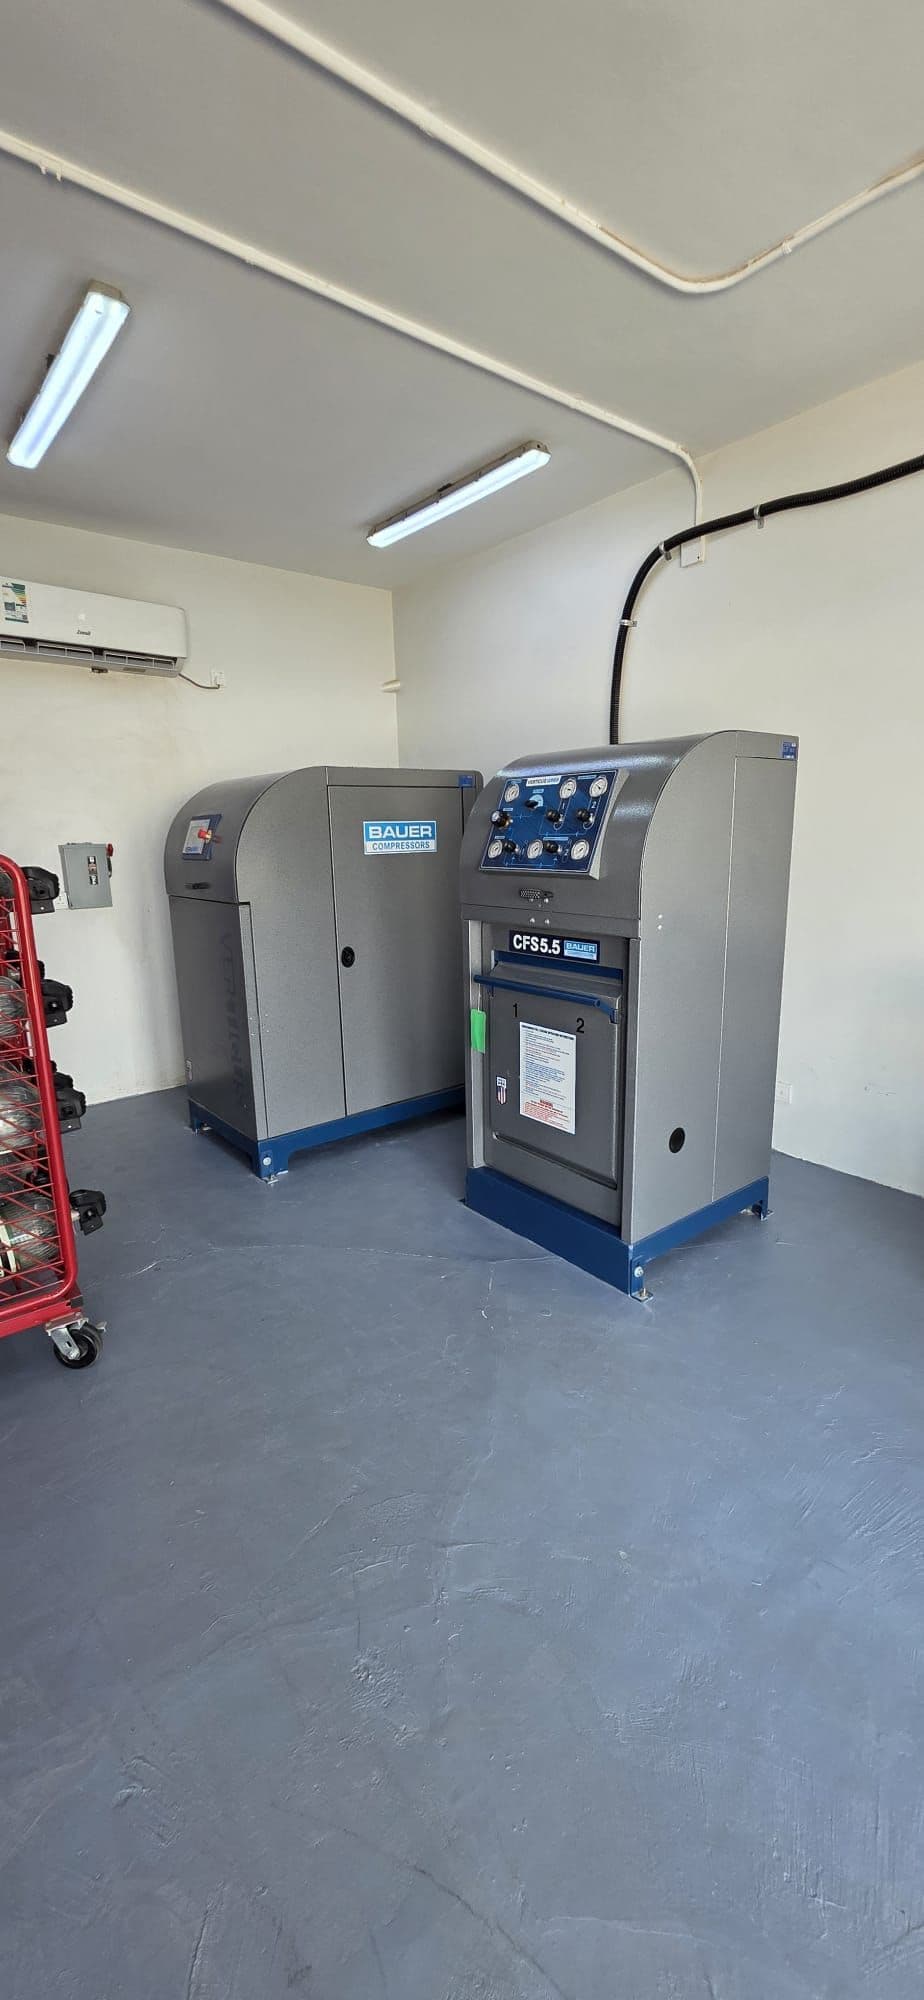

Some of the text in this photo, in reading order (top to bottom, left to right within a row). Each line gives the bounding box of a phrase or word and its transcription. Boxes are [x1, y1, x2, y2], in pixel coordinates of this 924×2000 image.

[369, 826, 432, 839] BAUER
[372, 841, 430, 851] COMPRESSORS
[566, 943, 595, 954] BAUER
[513, 1003, 518, 1018] 1
[576, 1018, 585, 1034] 2
